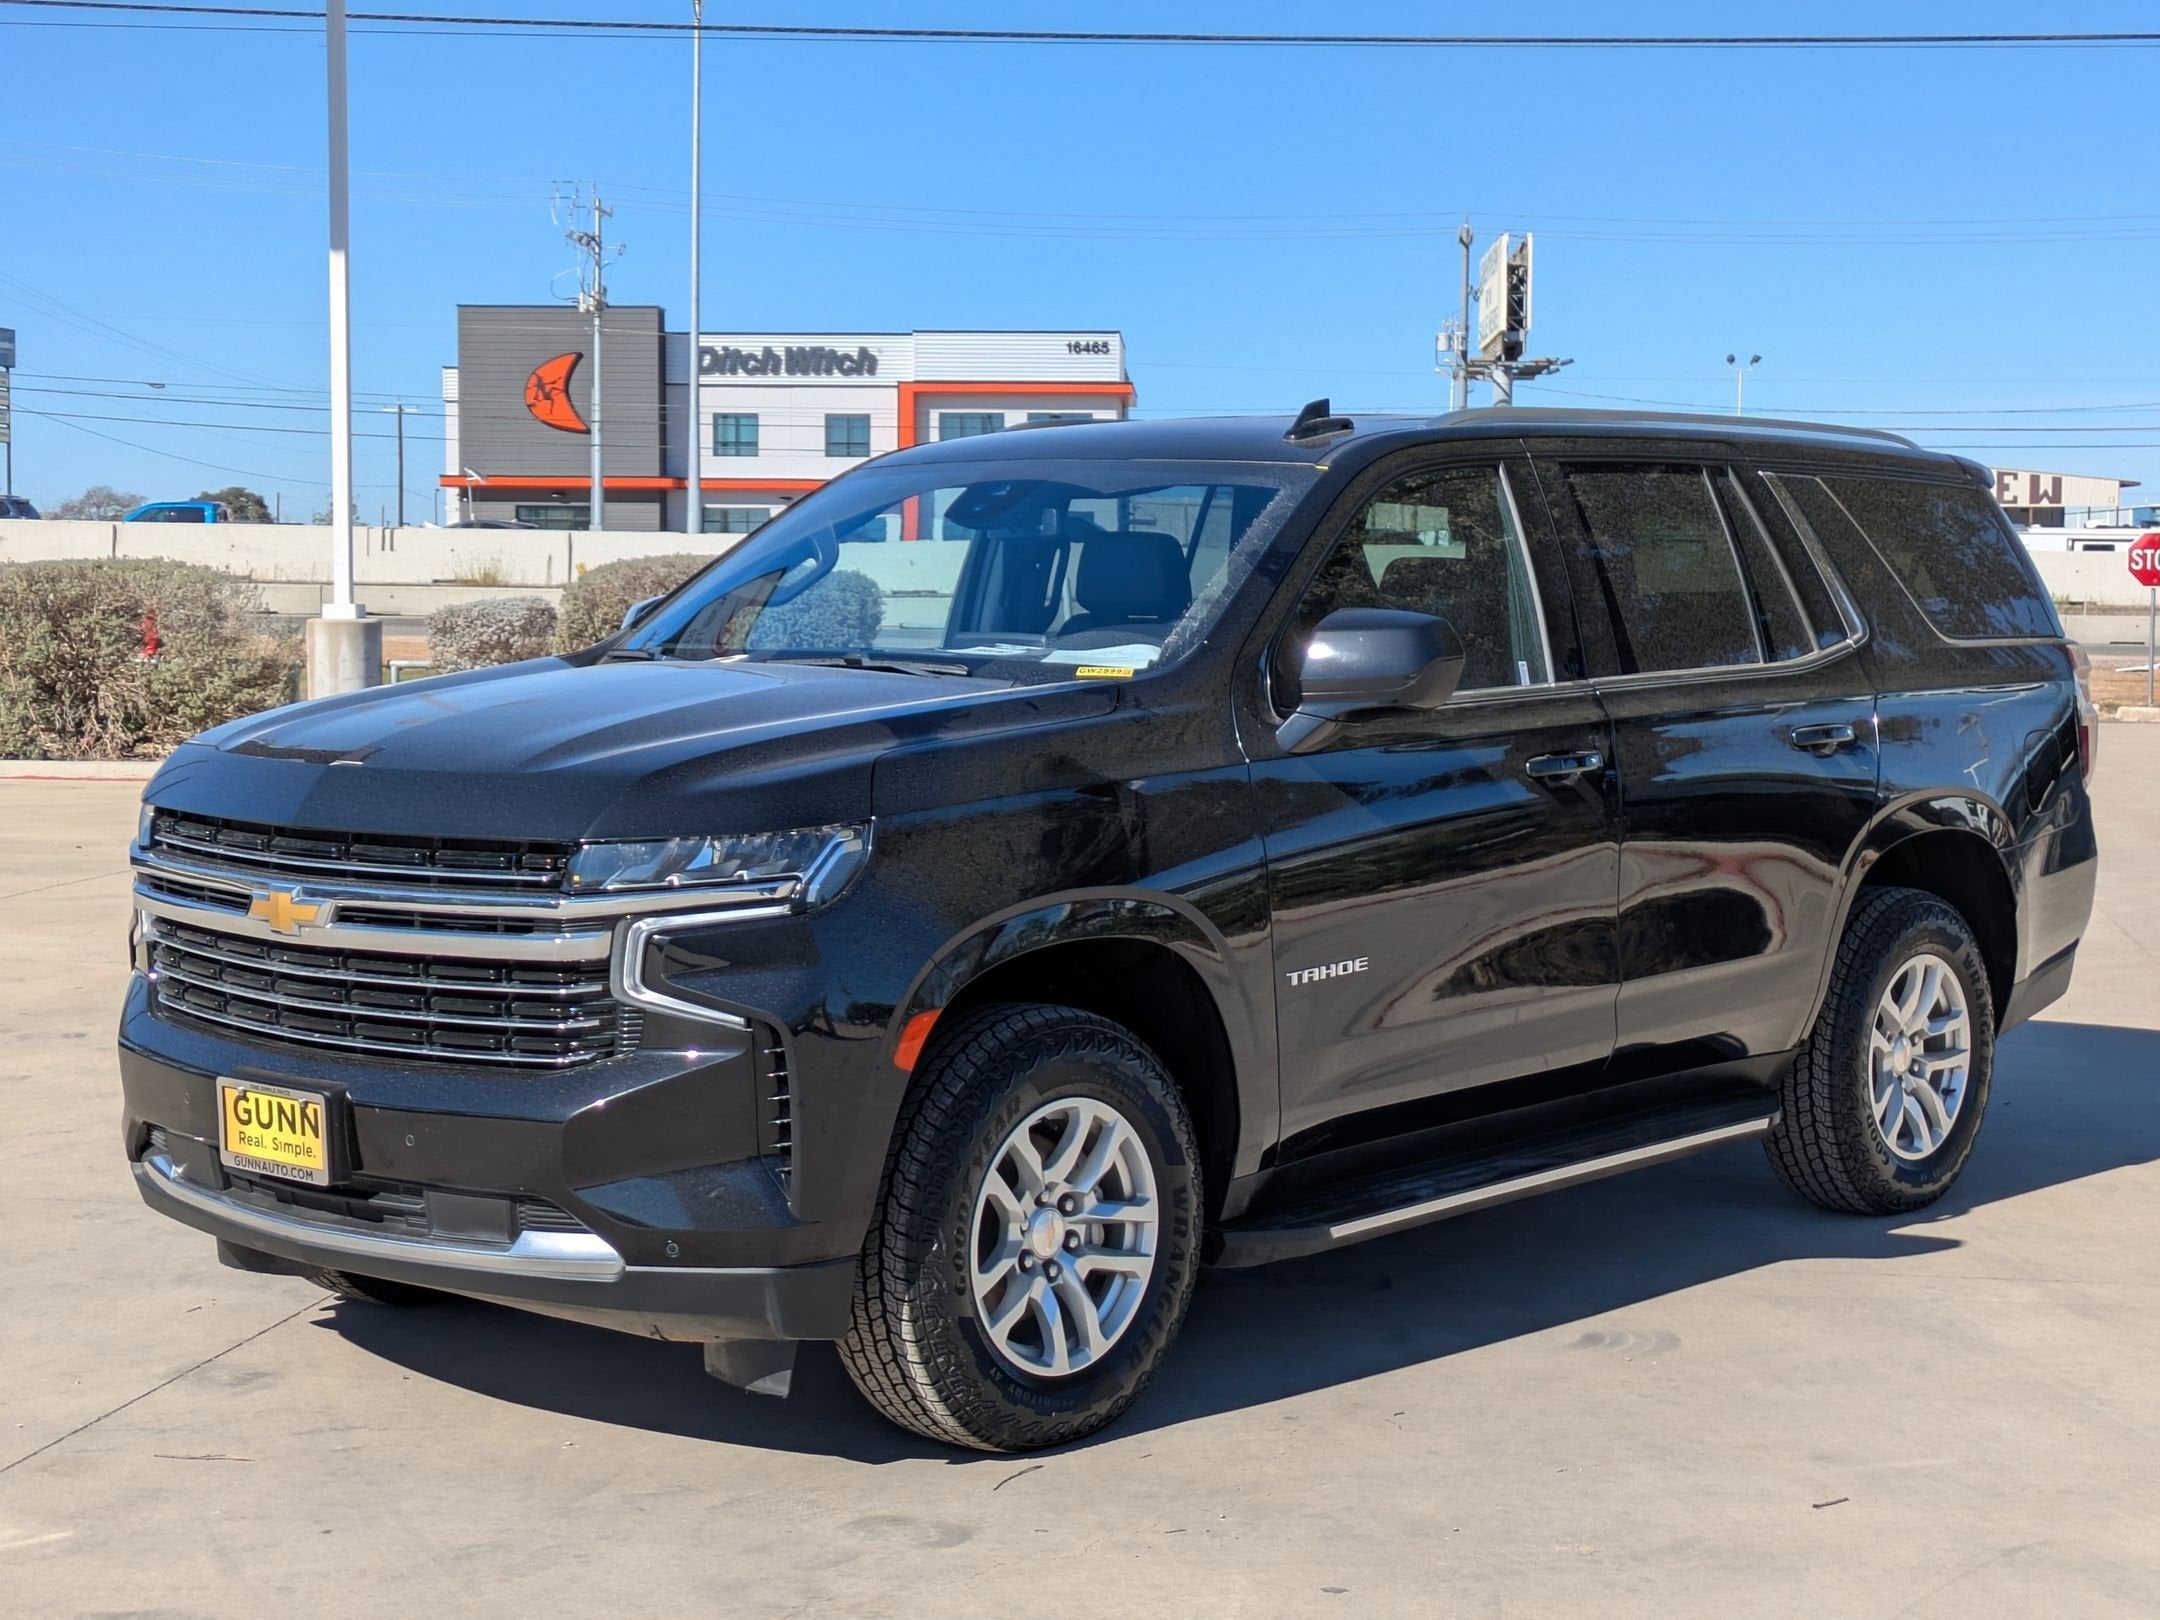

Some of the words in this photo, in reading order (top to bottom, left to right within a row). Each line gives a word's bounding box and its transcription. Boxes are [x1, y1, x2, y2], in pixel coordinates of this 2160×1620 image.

[700, 346, 782, 376] Ditch
[785, 346, 879, 377] Witch
[1067, 341, 1110, 354] 16465
[1286, 957, 1368, 986] TAHOE
[234, 1094, 320, 1139] GUNN
[239, 1131, 267, 1149] Real.
[272, 1137, 316, 1159] Simple.
[234, 1156, 314, 1181] GUNNAUTO.COM
